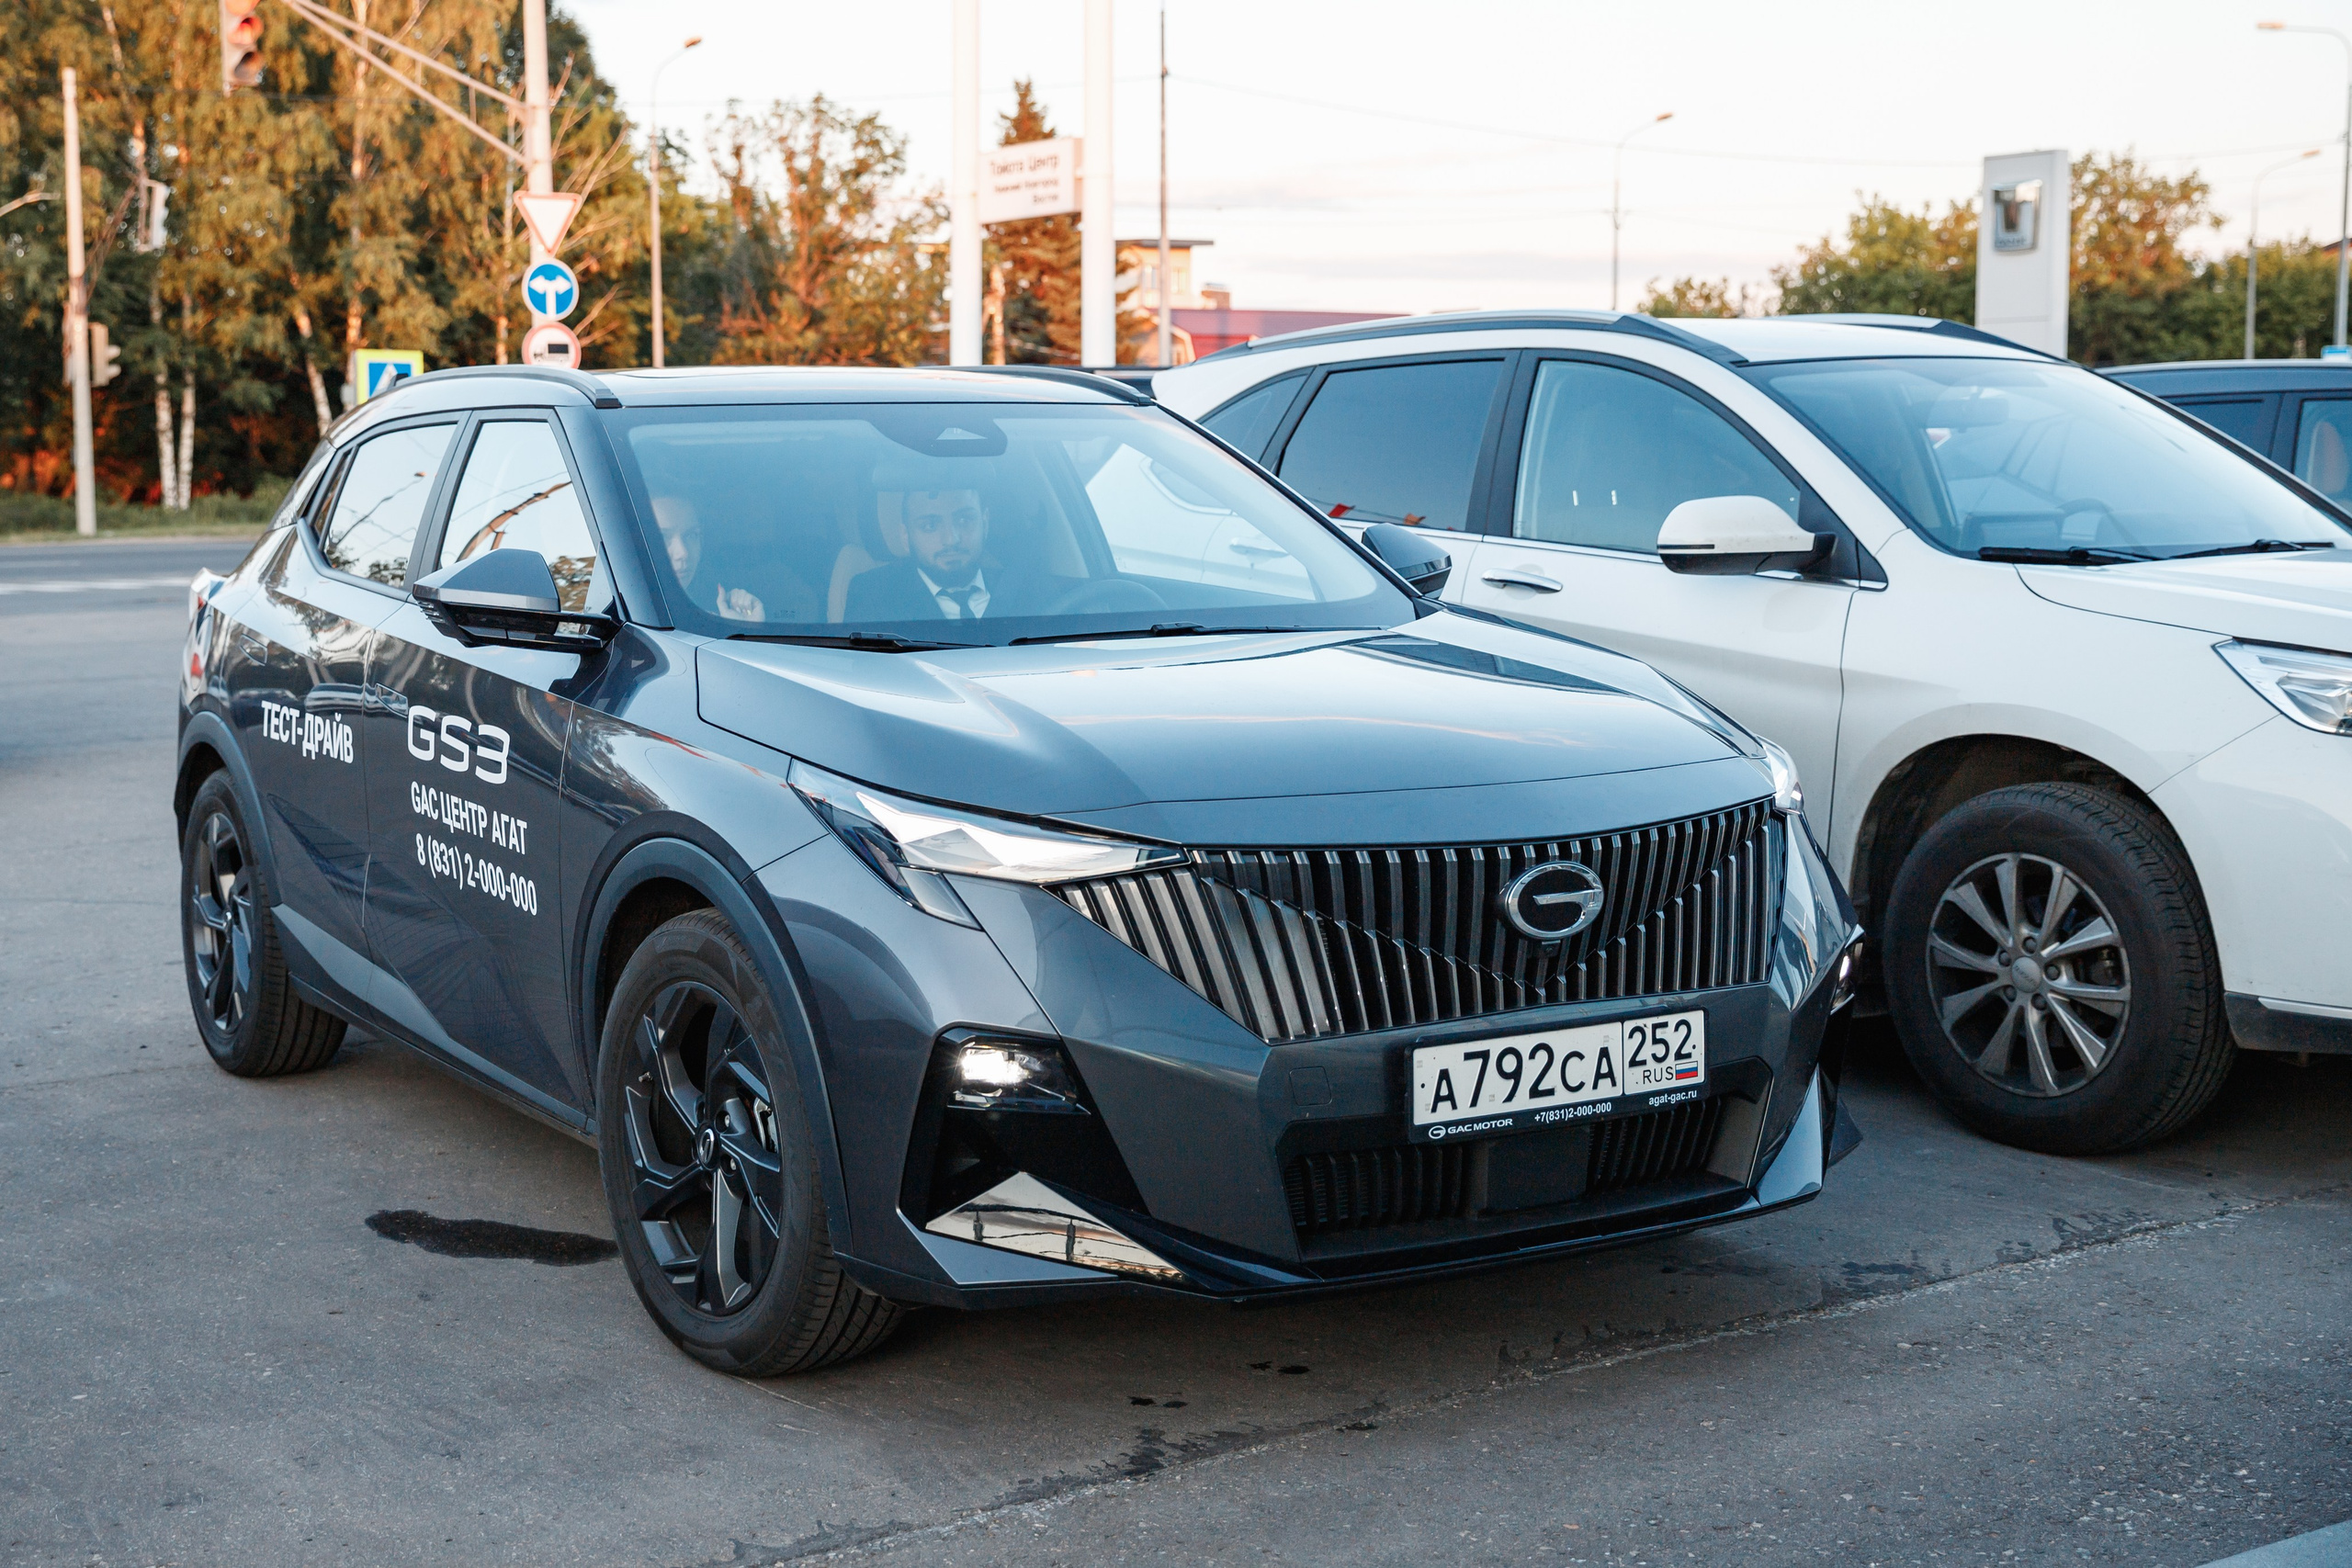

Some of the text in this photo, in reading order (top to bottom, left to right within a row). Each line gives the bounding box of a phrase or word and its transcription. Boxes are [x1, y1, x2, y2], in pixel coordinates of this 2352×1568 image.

[261, 700, 355, 764] ТЕСТ-ДРАЙВ
[407, 705, 511, 784] GS3
[411, 781, 527, 855] GAC ЦЕНТР АГАТ
[415, 833, 537, 916] 8 (831) 2-000-000
[1627, 1019, 1692, 1068] 252
[1643, 1066, 1674, 1085] RUS
[1648, 1089, 1698, 1107] agat-gac.ru
[1534, 1102, 1612, 1123] +7(831)2-000-000
